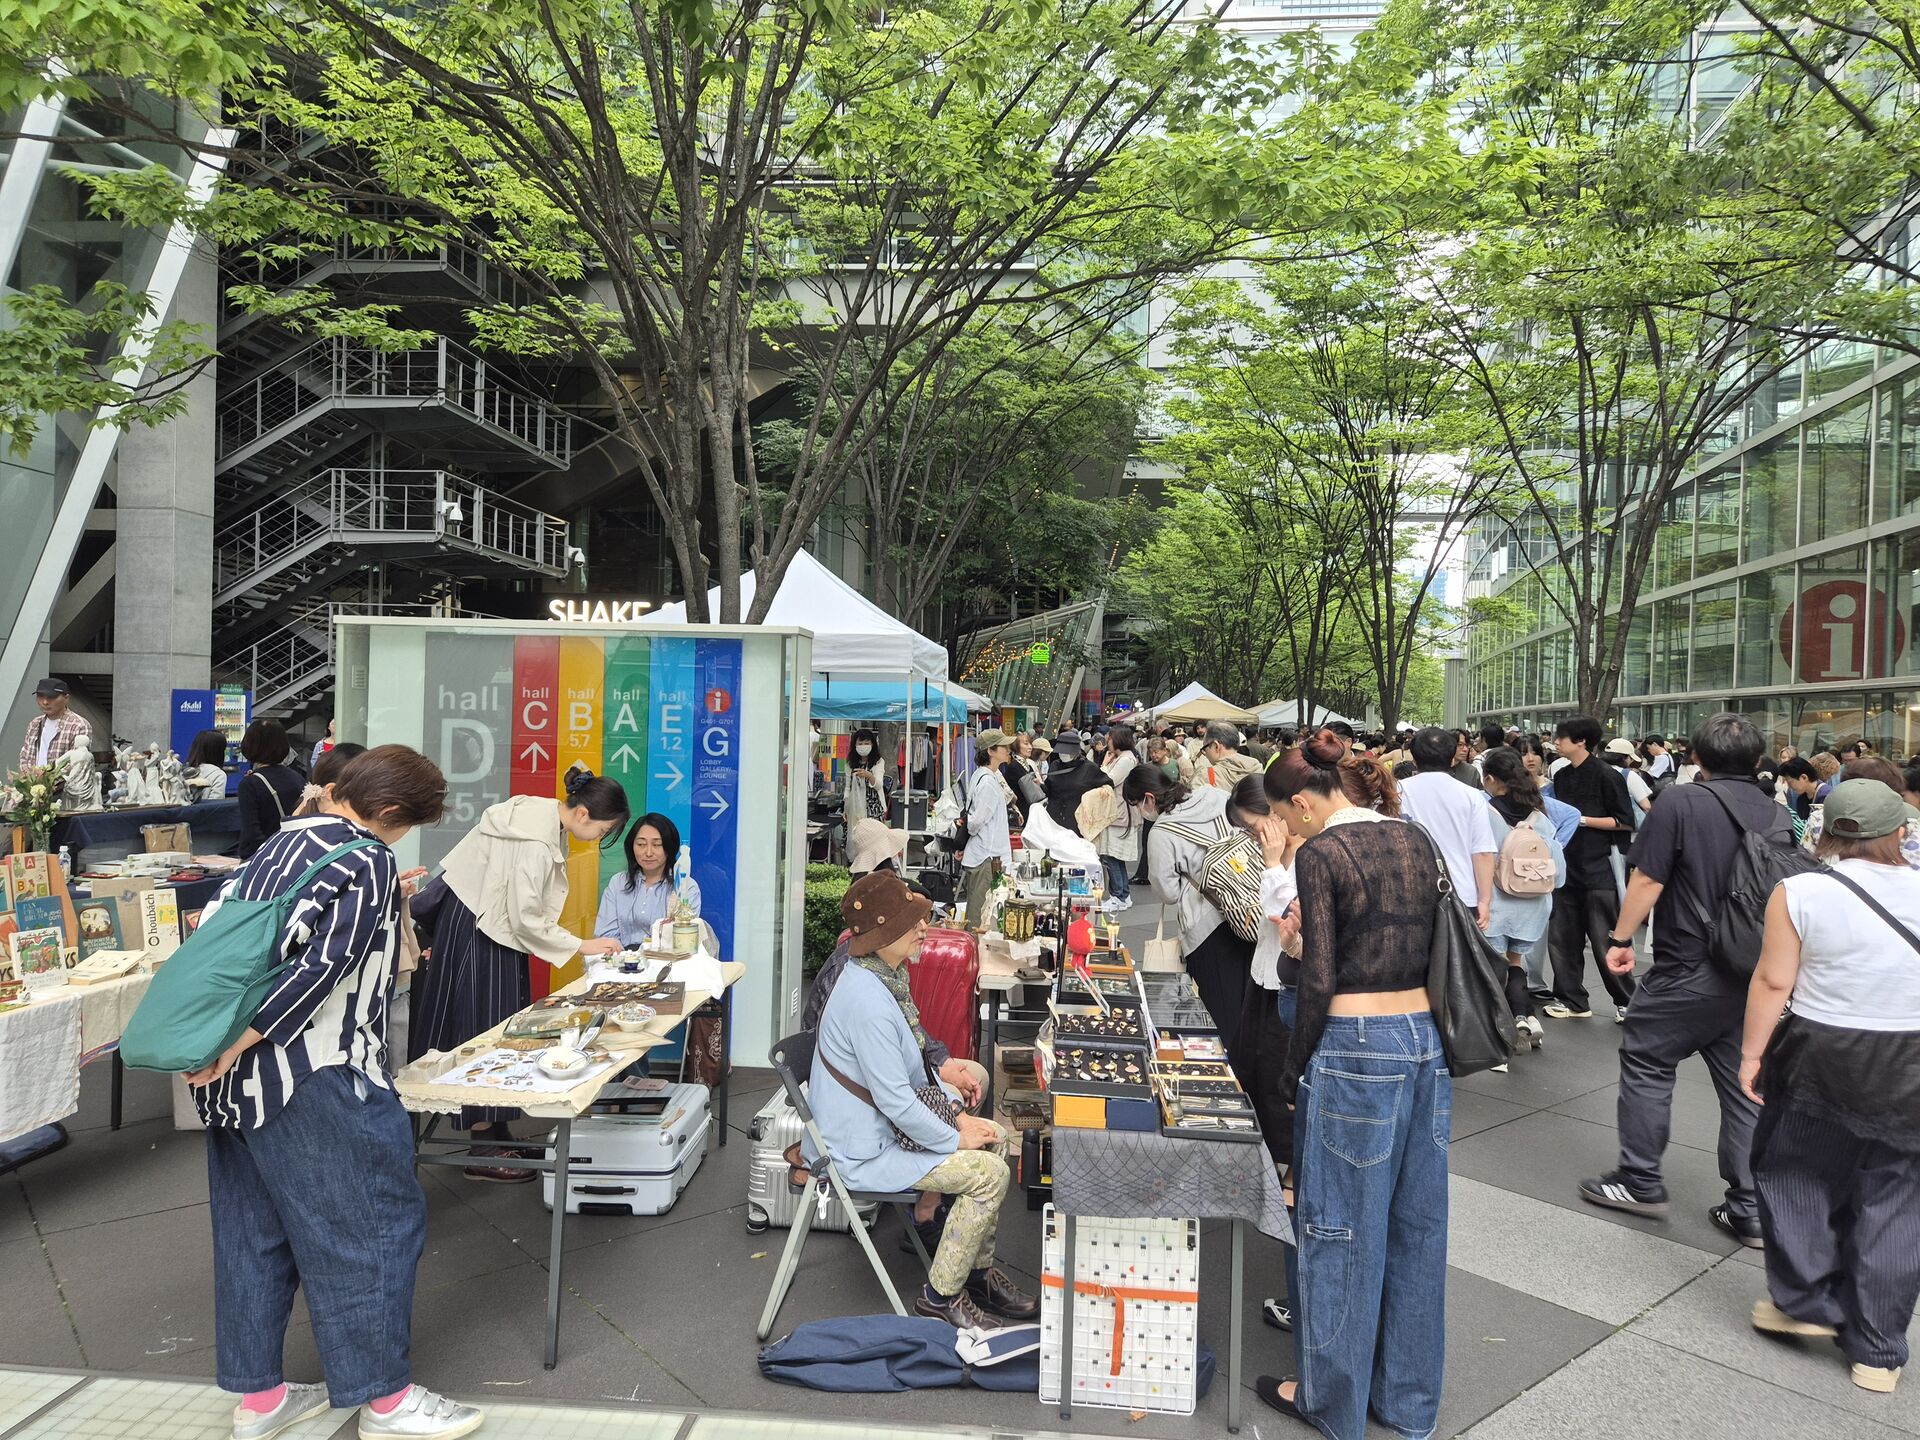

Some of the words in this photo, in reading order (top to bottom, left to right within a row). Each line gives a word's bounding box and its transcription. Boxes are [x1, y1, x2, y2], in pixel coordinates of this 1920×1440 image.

[438, 684, 499, 711] hall
[522, 686, 550, 699] hall
[567, 687, 595, 699] hall
[613, 688, 640, 701] hall
[659, 690, 686, 702] hall
[180, 700, 202, 710] Asahi
[522, 701, 549, 730] C
[569, 701, 593, 731] B
[612, 703, 639, 732] A
[661, 704, 682, 733] E
[569, 733, 591, 749] 5,7
[660, 736, 682, 752] 1,2
[703, 727, 729, 757] G
[440, 718, 495, 783] D
[26, 857, 34, 868] A
[17, 880, 25, 891] B
